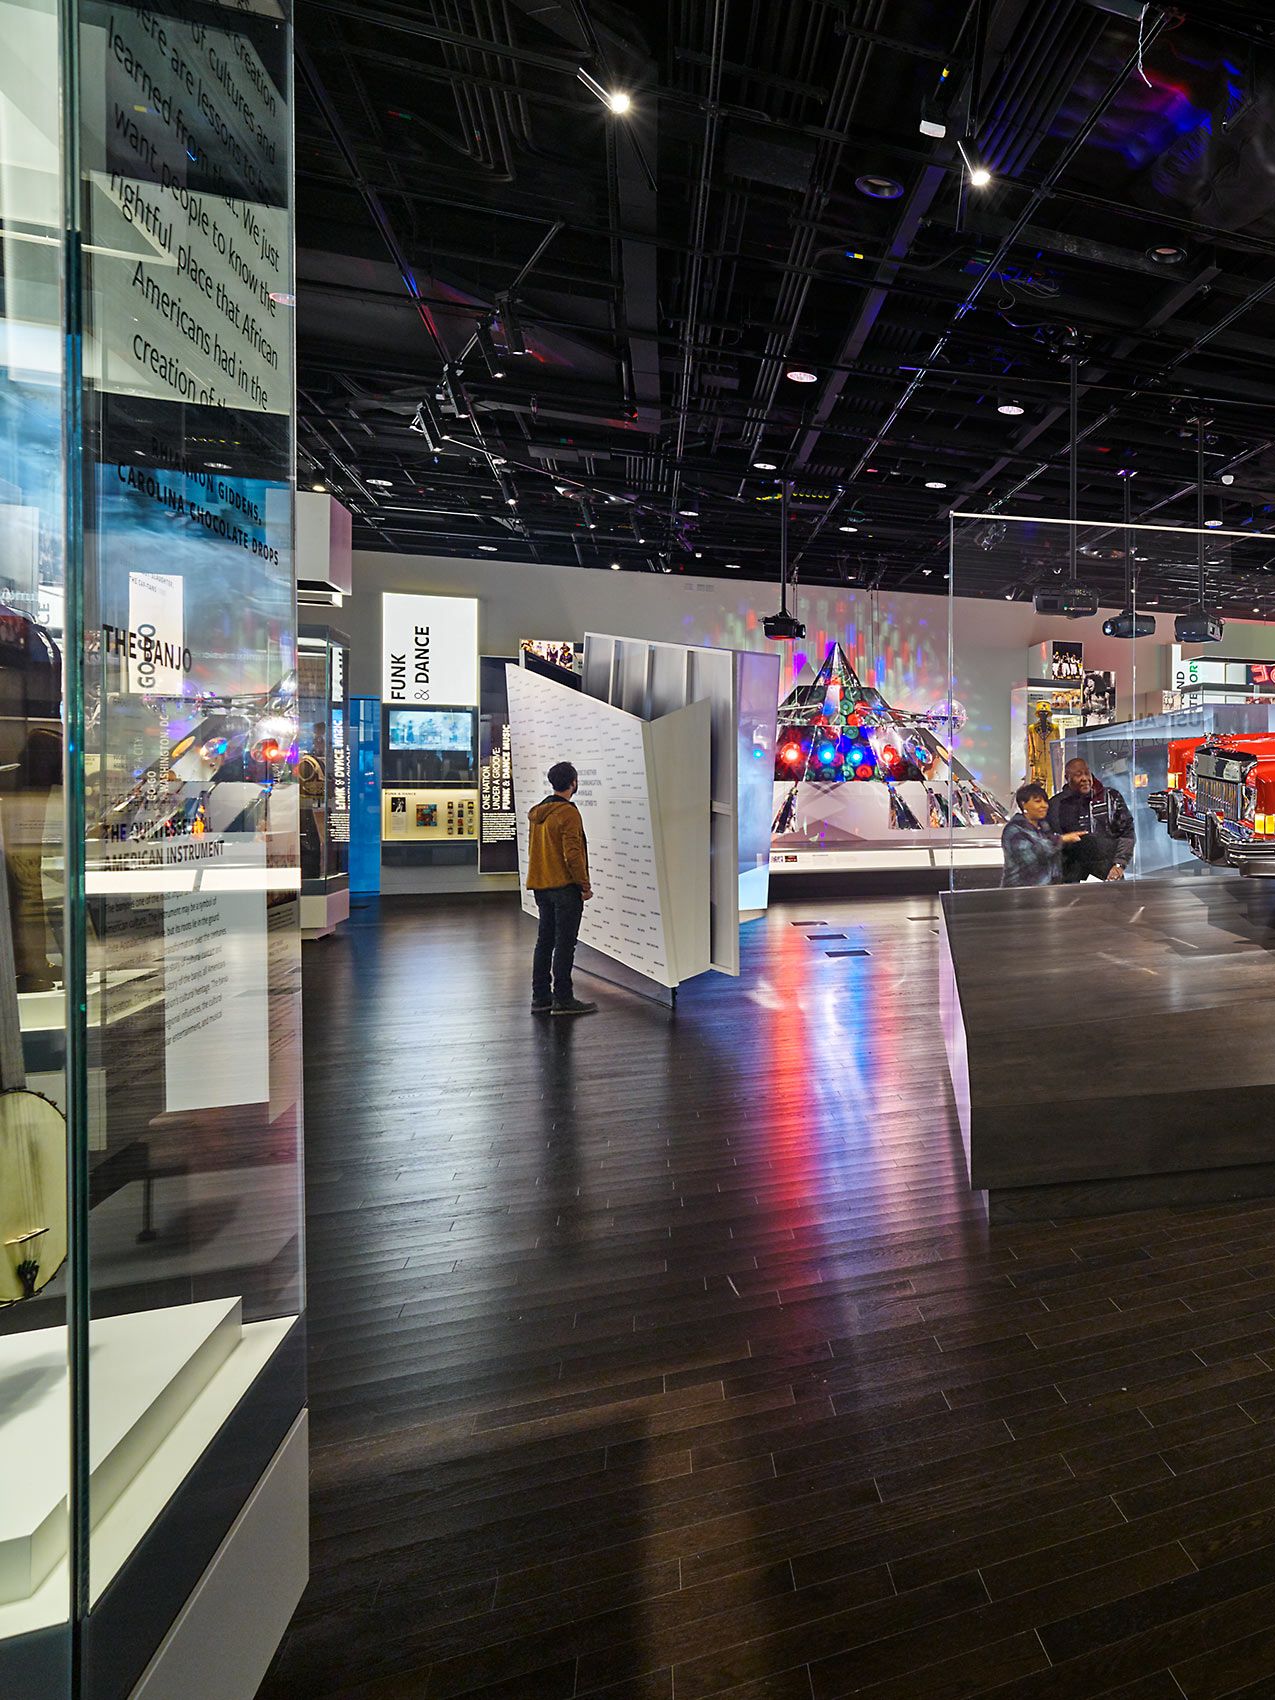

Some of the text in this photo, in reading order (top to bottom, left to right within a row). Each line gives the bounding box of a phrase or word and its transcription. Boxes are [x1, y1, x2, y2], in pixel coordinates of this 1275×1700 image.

[233, 34, 276, 117] creation
[171, 48, 194, 95] are
[197, 79, 241, 165] lessons
[209, 47, 255, 132] cultures
[256, 124, 276, 164] and
[108, 16, 172, 125] learned
[242, 202, 260, 246] We
[260, 229, 280, 273] just
[114, 102, 276, 318] want people to know the
[111, 168, 278, 370] rightful place that African
[132, 260, 268, 411] Americans had in the
[133, 334, 196, 402] creation
[117, 461, 279, 566] CAROLINA CHOCOLATE DROPS
[218, 481, 262, 526] GIDDENS,
[102, 624, 192, 673] THE BANJO
[391, 653, 406, 700] FUNK
[414, 625, 430, 700] & DANCE
[492, 747, 501, 778] GROOVE:
[502, 724, 511, 751] MUSIC
[502, 751, 511, 779] DANCE
[482, 765, 491, 810] ONE NATION
[492, 785, 501, 810] UNDER
[502, 787, 511, 810] FUNK
[166, 840, 225, 864] INSTRUMENT
